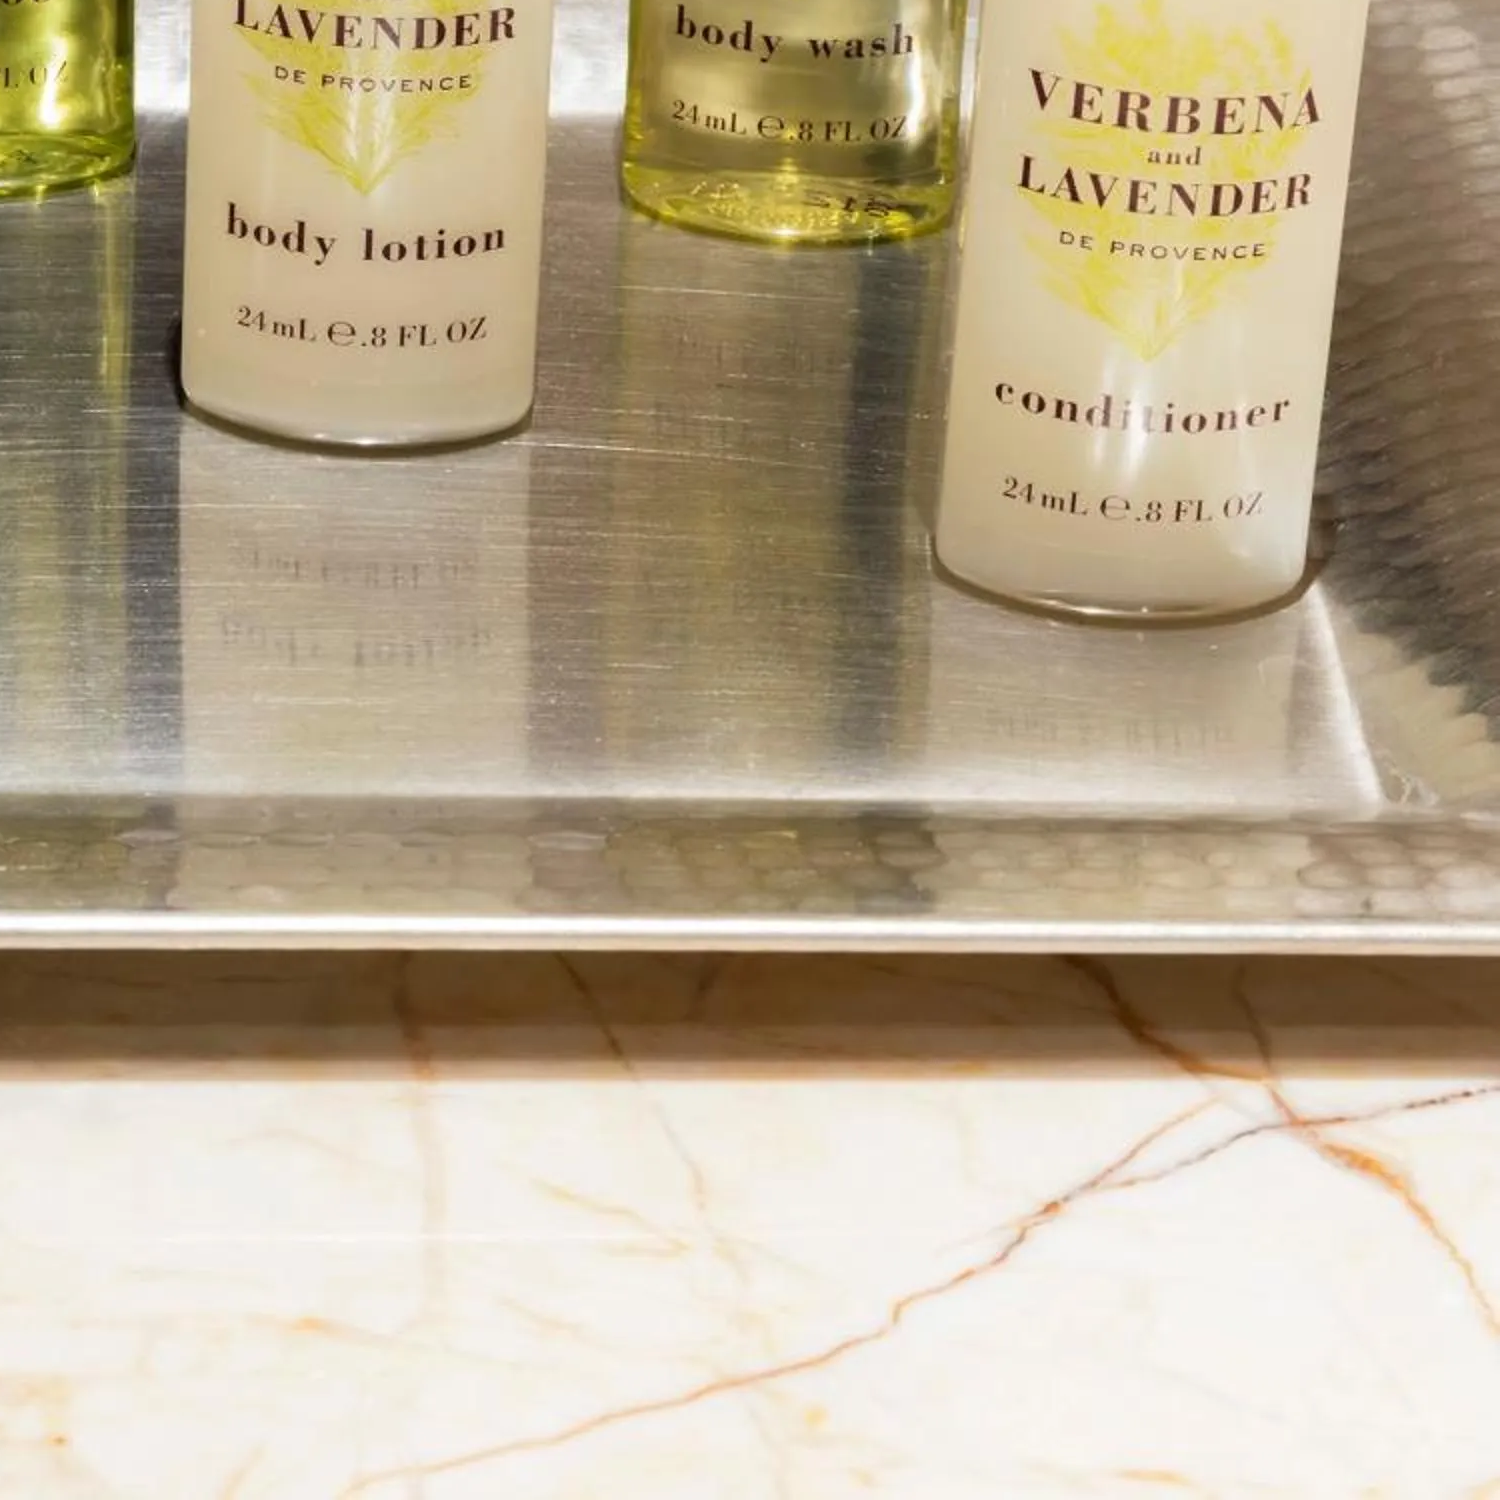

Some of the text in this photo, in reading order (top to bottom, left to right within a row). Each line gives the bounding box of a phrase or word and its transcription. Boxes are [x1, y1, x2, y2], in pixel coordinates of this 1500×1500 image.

[675, 4, 913, 63] body wash
[275, 66, 472, 92] DE PROVENCE
[1028, 68, 1323, 135] VERBENA
[825, 121, 860, 142] FL
[1148, 147, 1201, 166] and
[1016, 154, 1311, 217] LAVENDER
[228, 202, 505, 265] body lotion
[1059, 231, 1266, 261] DE PROVENCE
[399, 325, 436, 347] FL
[446, 316, 487, 343] OZ
[995, 382, 1289, 434] conditioner
[1174, 499, 1212, 522] FL
